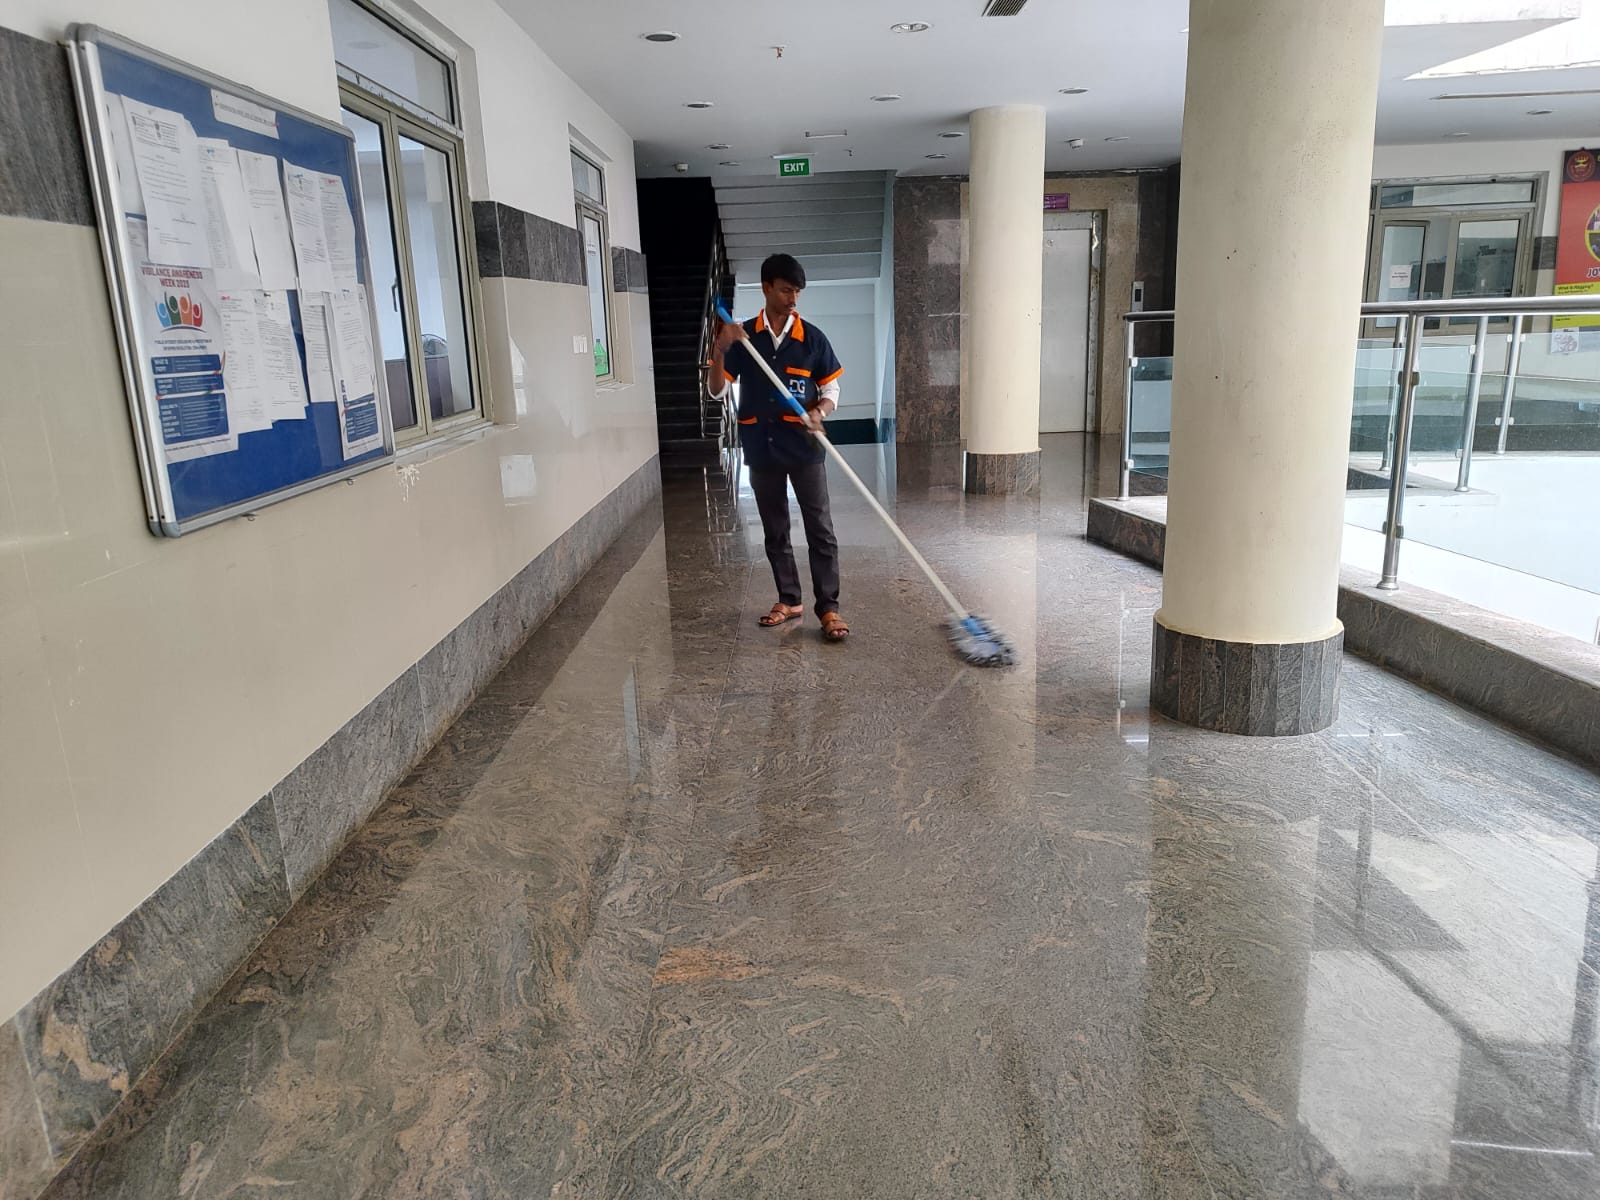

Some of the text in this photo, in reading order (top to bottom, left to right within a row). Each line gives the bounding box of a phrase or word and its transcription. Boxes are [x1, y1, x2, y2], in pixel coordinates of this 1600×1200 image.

[783, 162, 805, 173] EXIT
[141, 266, 203, 280] VIGILANCE AWARENESS
[1587, 267, 1600, 278] JO
[160, 278, 175, 287] WEEK
